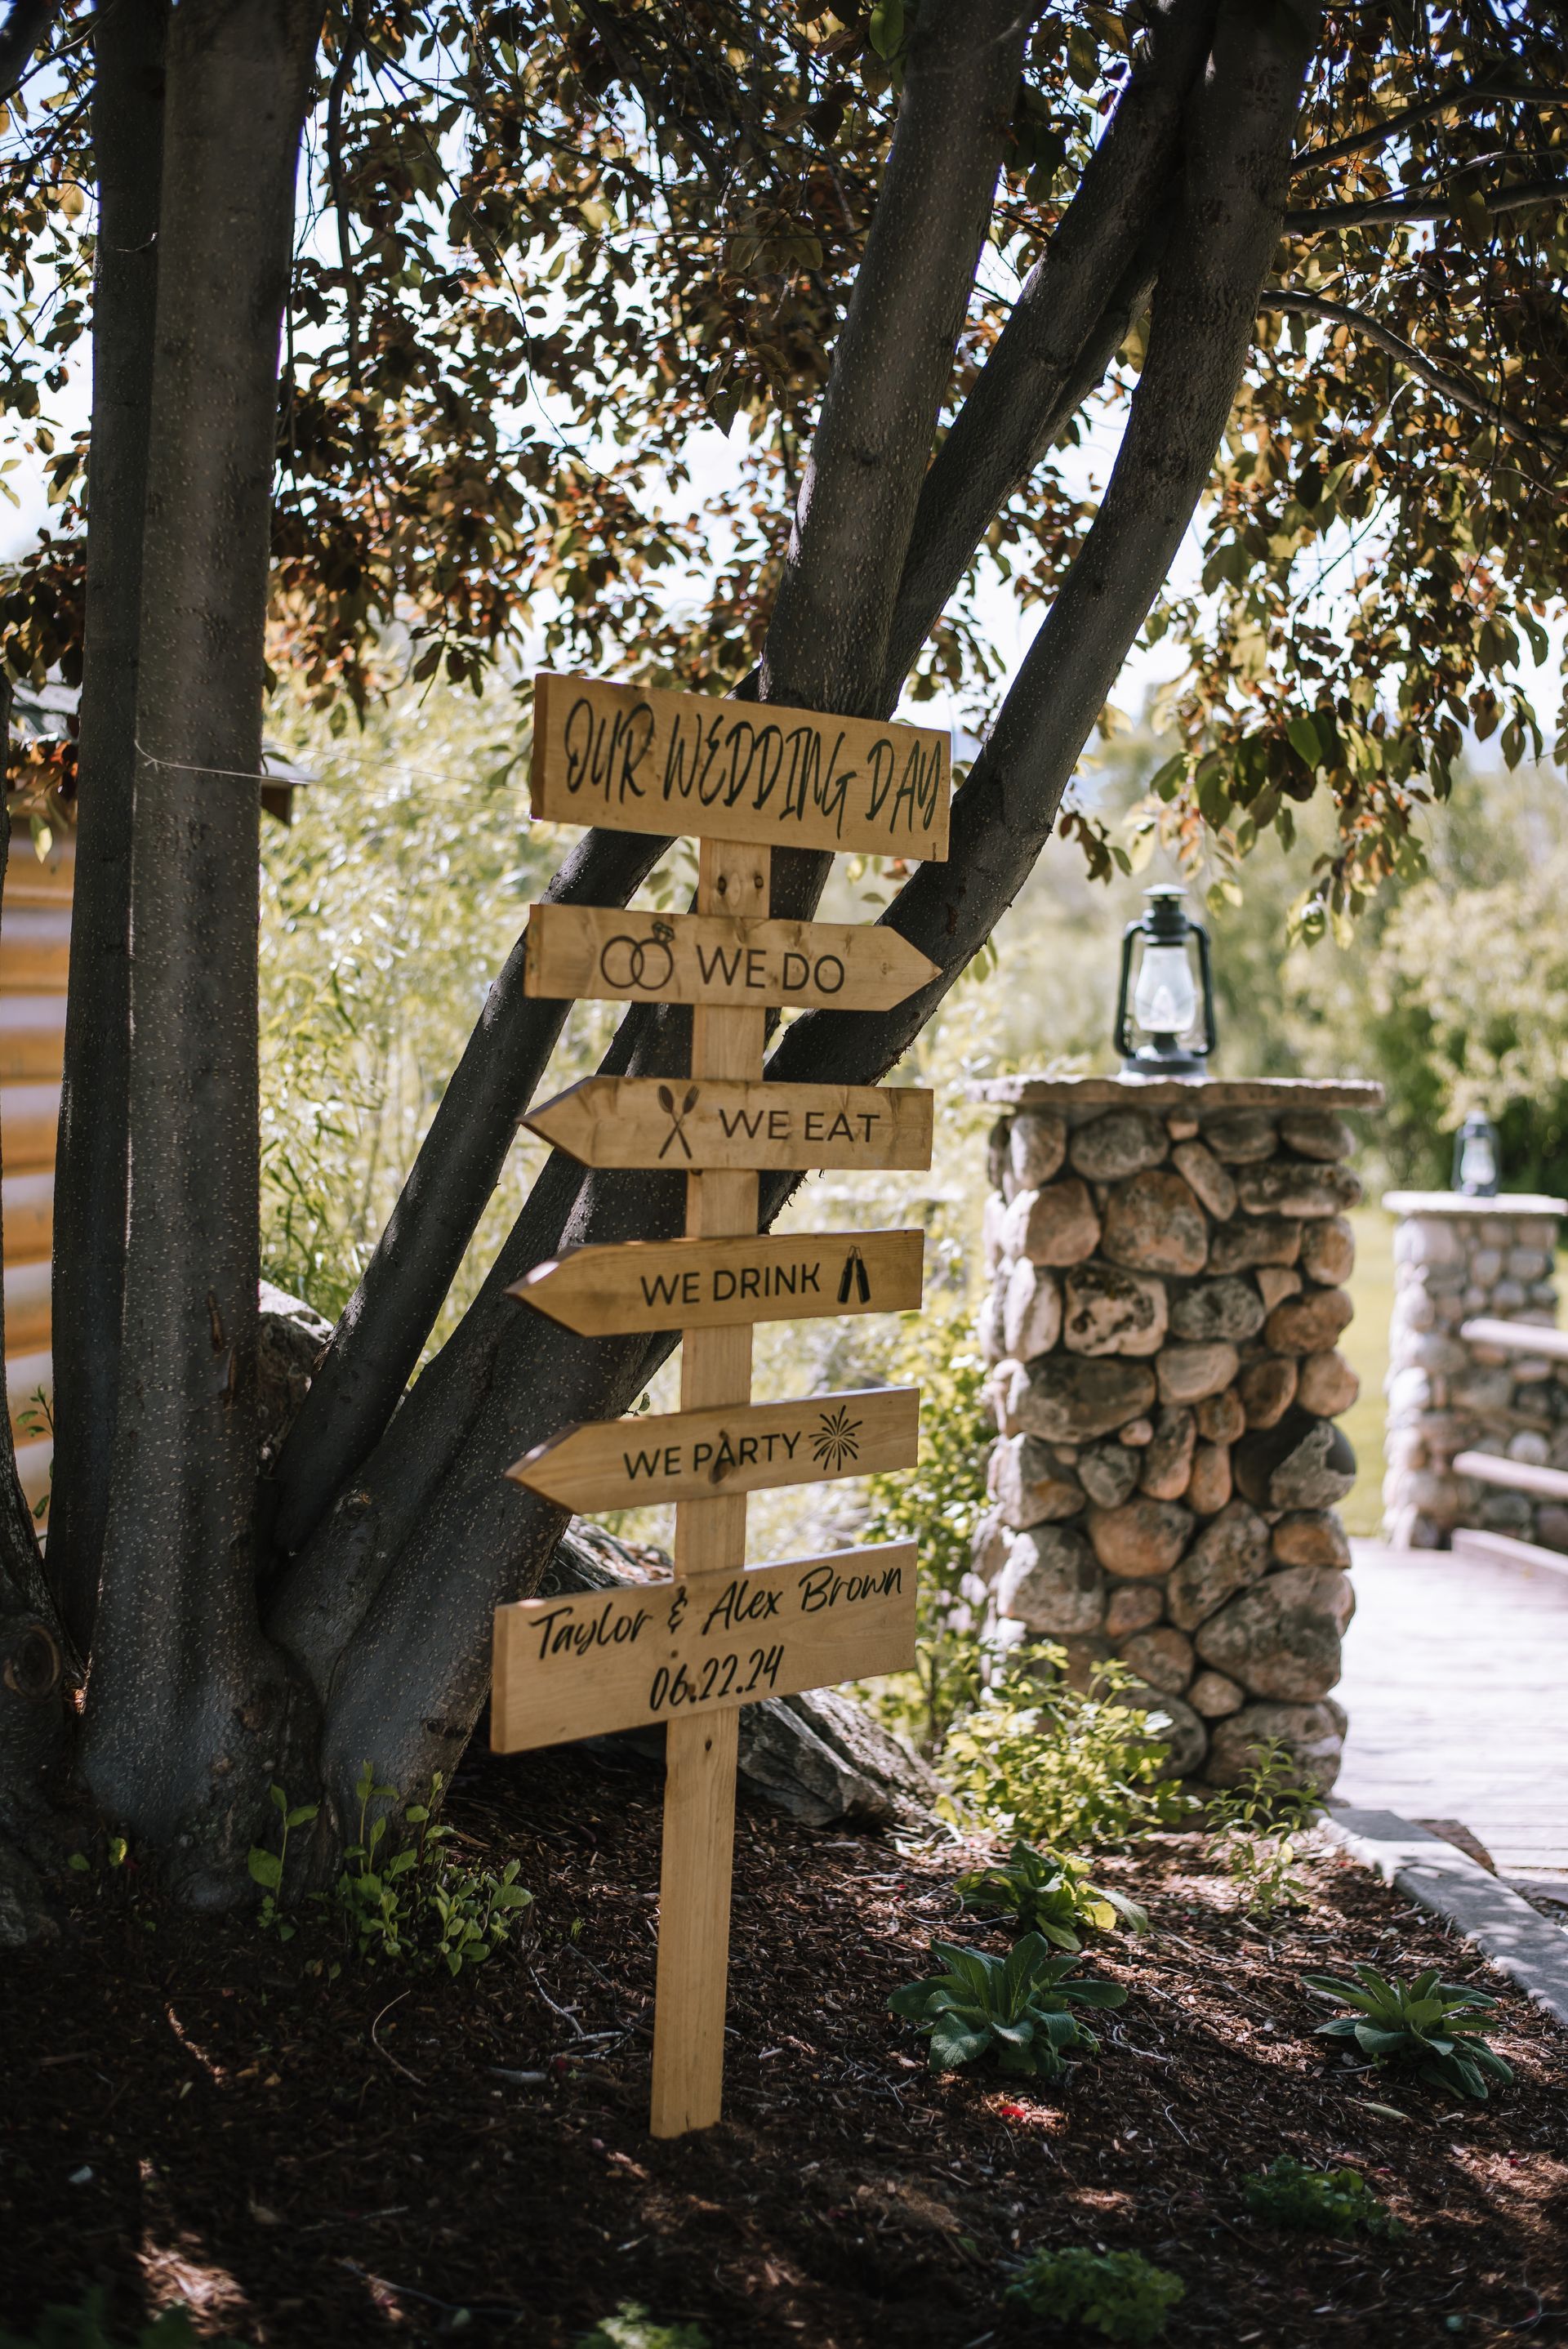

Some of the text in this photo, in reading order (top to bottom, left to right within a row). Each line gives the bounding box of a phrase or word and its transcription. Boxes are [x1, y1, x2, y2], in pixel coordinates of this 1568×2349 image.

[565, 698, 942, 840] OUR WEDDING DAY
[697, 944, 845, 994] WE DO
[719, 1108, 880, 1143] WE EAT
[640, 1262, 821, 1307] WE DRINK
[623, 1431, 802, 1480] WE PARTY
[528, 1566, 902, 1660] Taylor & Alex Brown
[650, 1645, 785, 1711] 06.22.24
